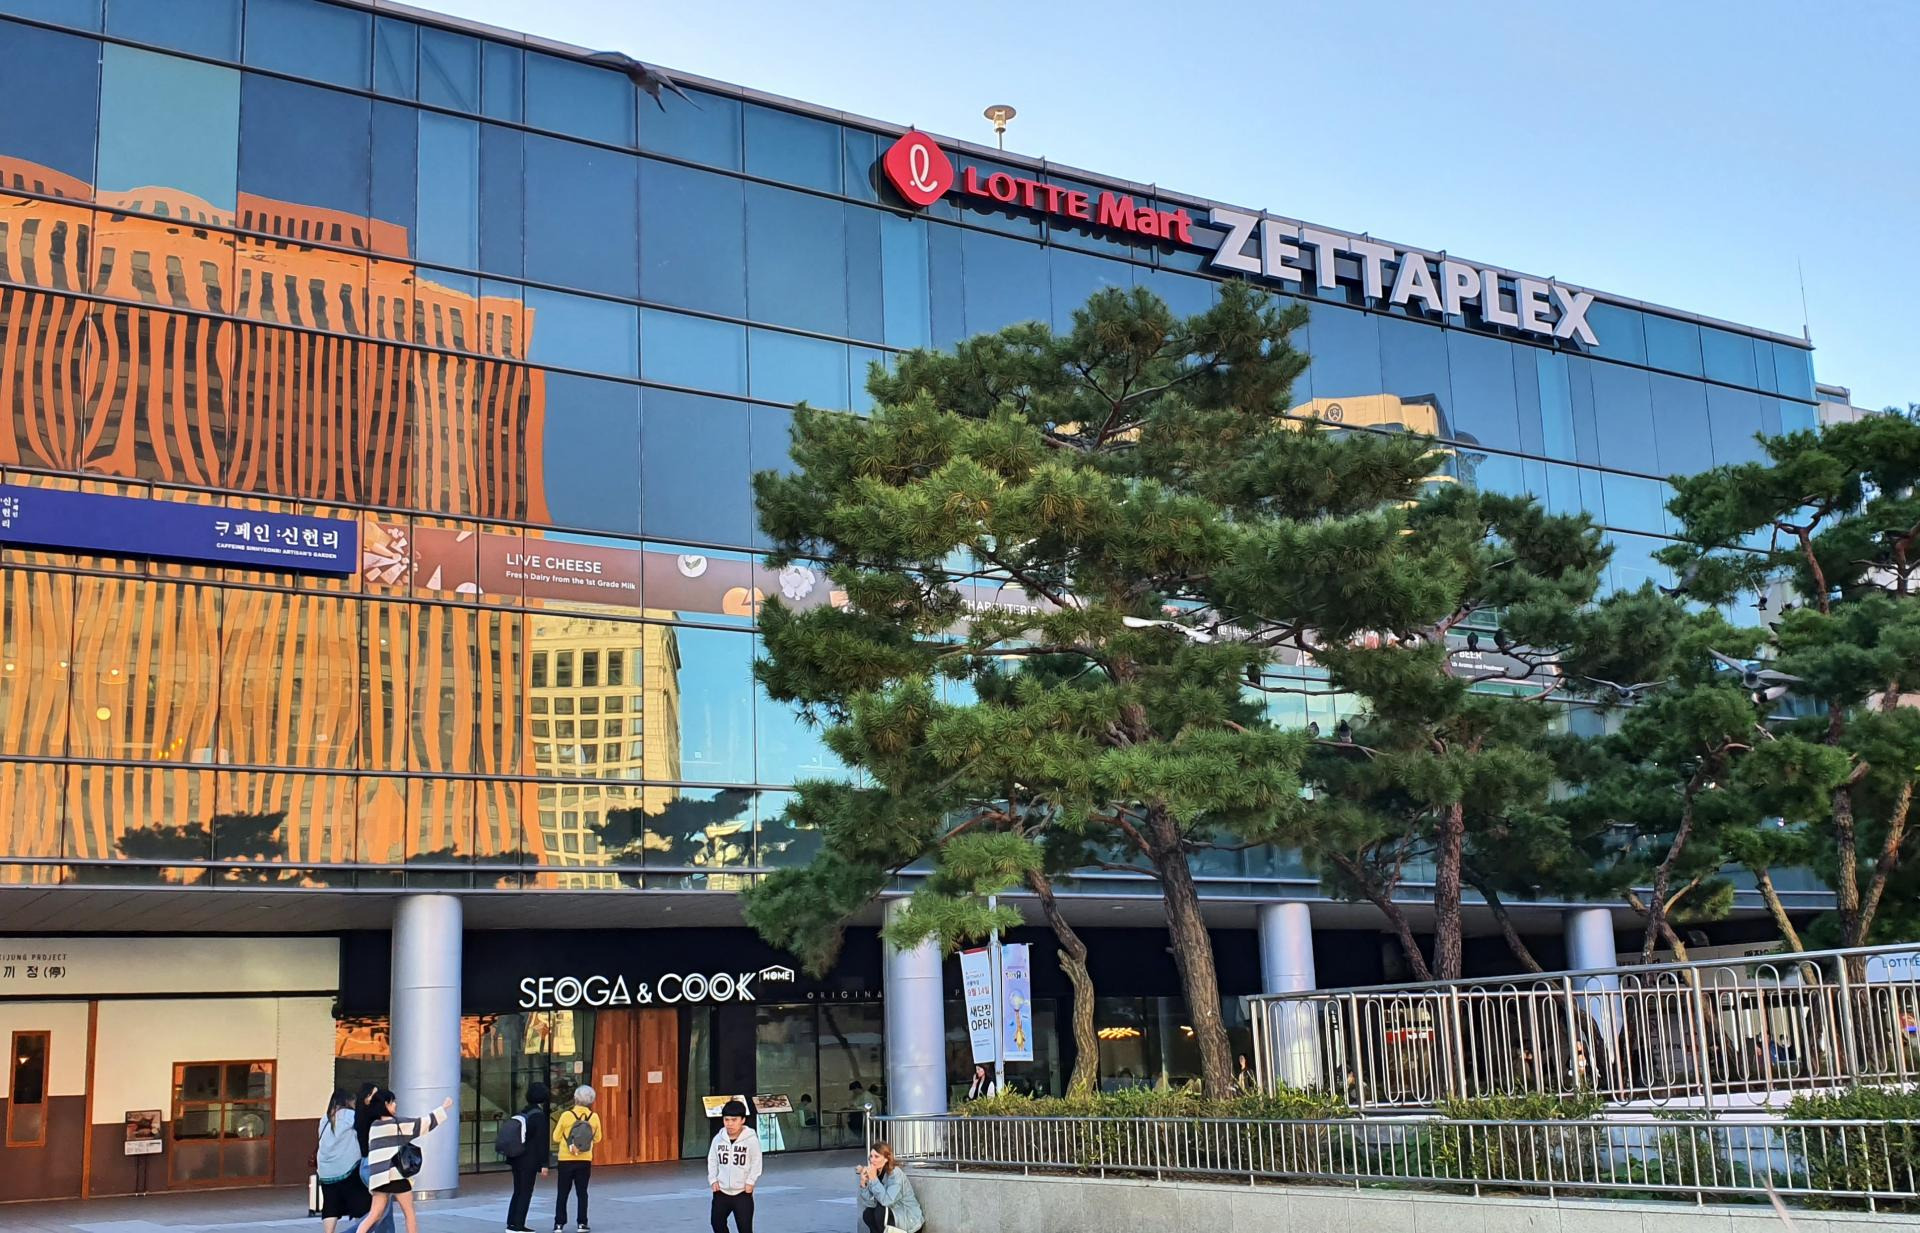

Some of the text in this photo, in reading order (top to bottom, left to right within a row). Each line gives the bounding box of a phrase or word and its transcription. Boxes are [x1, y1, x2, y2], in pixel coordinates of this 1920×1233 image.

[964, 166, 1193, 244] LOTTE Mart
[1210, 207, 1599, 347] ZETTAPLEX
[506, 552, 602, 574] LIVE CHEESE
[506, 571, 528, 579] Fresh
[530, 573, 550, 582] Dairy
[552, 575, 570, 583] from
[597, 580, 619, 588] Grade
[621, 582, 636, 590] Milk
[763, 971, 790, 981] HOME
[519, 972, 756, 1008] SEOGA & COOK
[807, 990, 883, 999] ORIGINA
[970, 1004, 991, 1017] 새단장
[971, 1019, 992, 1031] OPEN
[718, 1153, 746, 1166] 16 30
